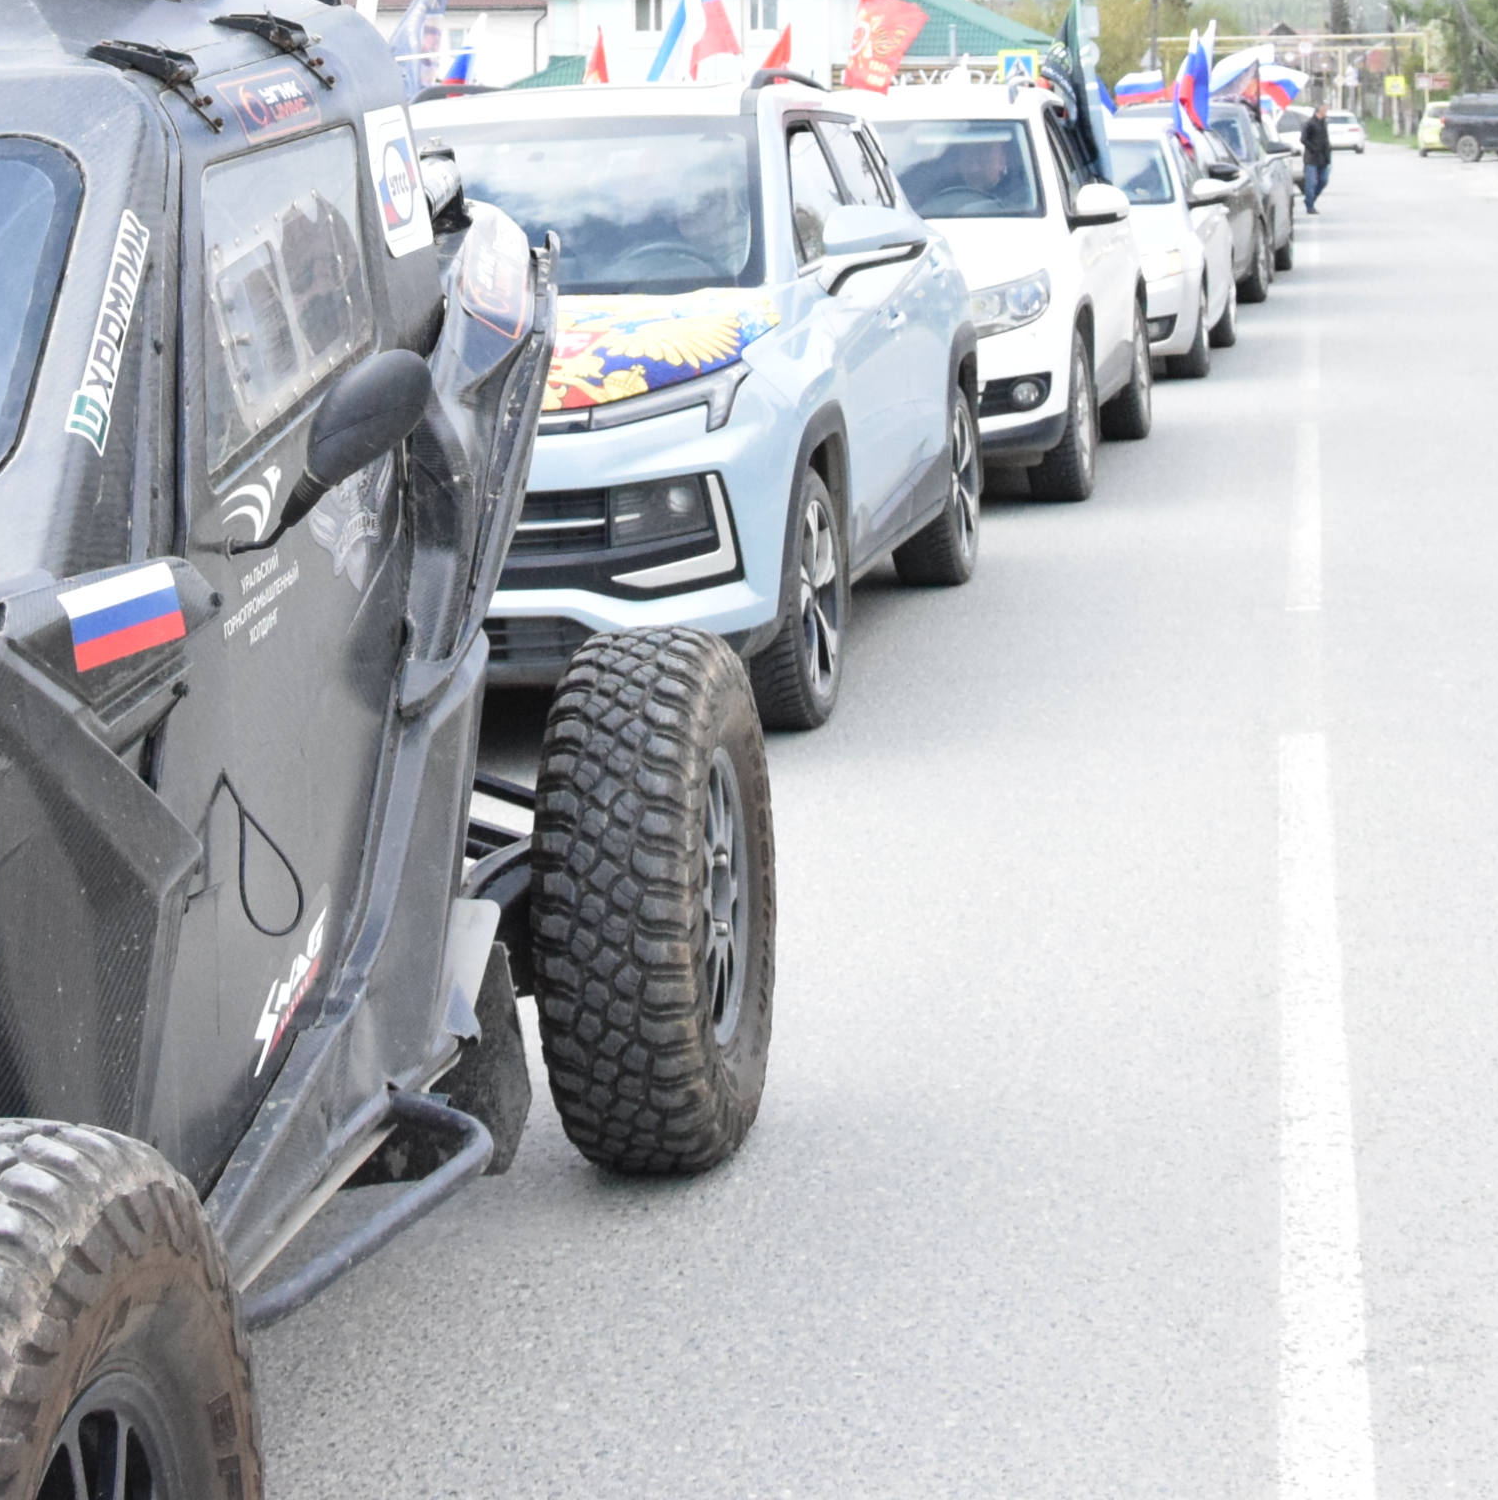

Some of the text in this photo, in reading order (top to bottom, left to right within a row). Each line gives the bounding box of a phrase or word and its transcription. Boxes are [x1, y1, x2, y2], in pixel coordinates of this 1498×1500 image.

[240, 548, 280, 595] УРАЛЬСКИЙ
[223, 560, 300, 640] ГОРНОПРОМЫШЛЕННЫЙ
[249, 607, 279, 647] ХОЛДИНГ
